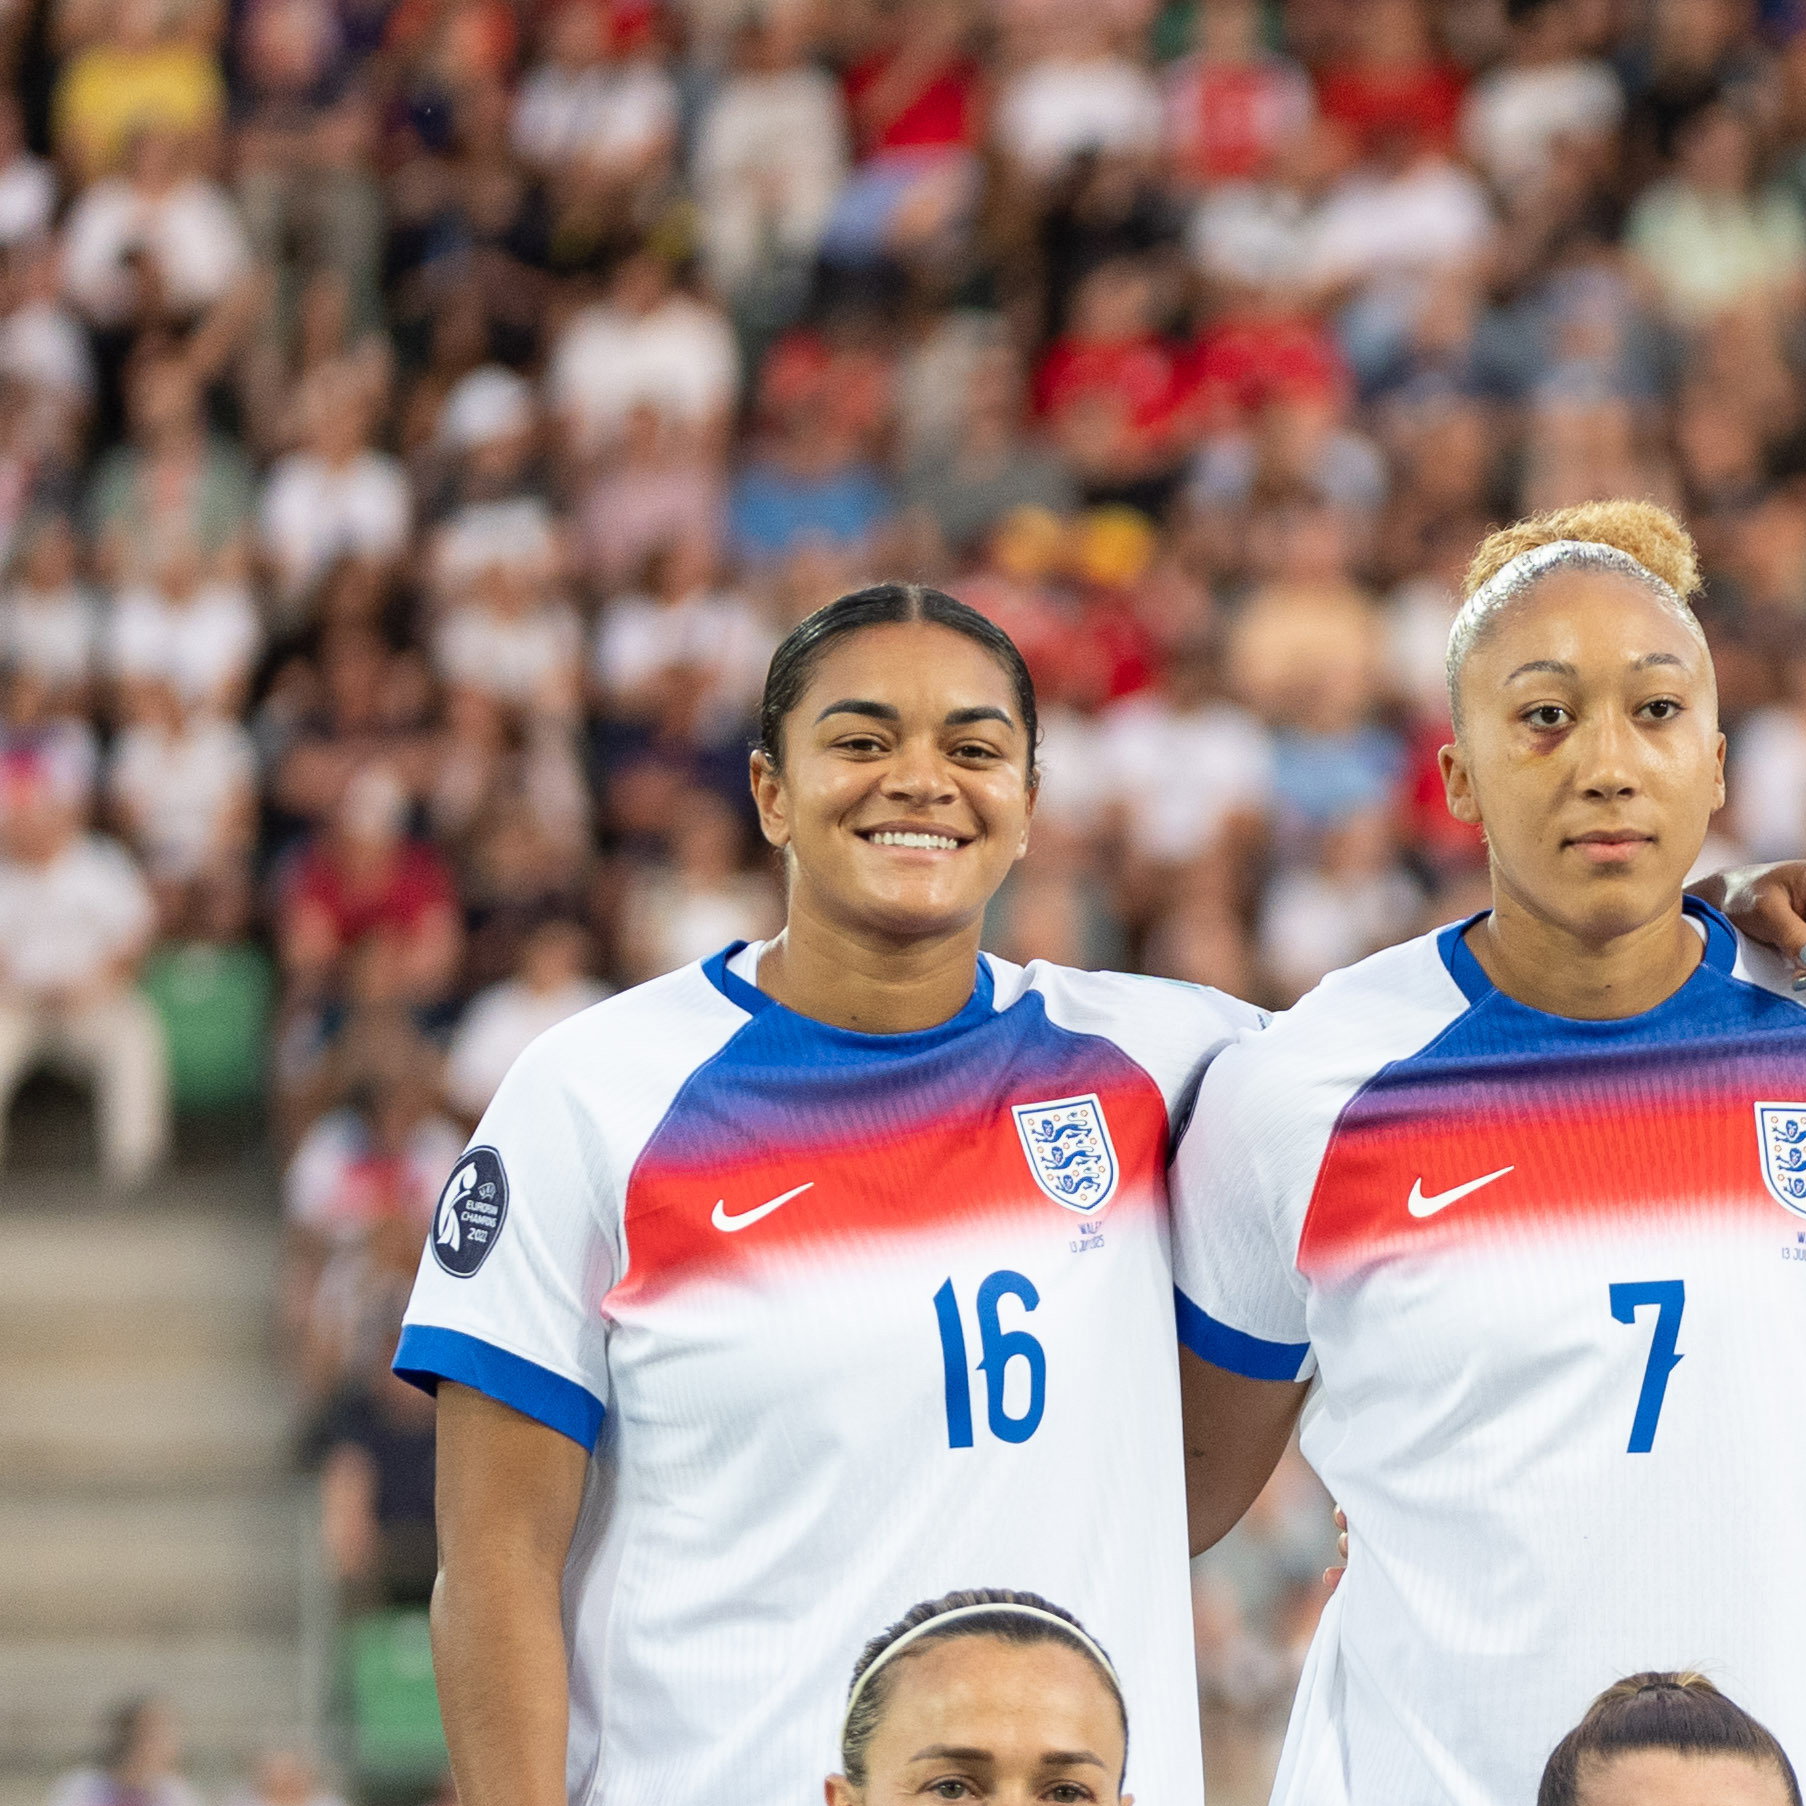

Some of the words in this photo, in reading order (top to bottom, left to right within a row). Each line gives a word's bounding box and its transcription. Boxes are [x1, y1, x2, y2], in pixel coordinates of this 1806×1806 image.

[1781, 1247, 1791, 1260] 13
[933, 1270, 1046, 1450] 16
[1609, 1279, 1686, 1453] 7
